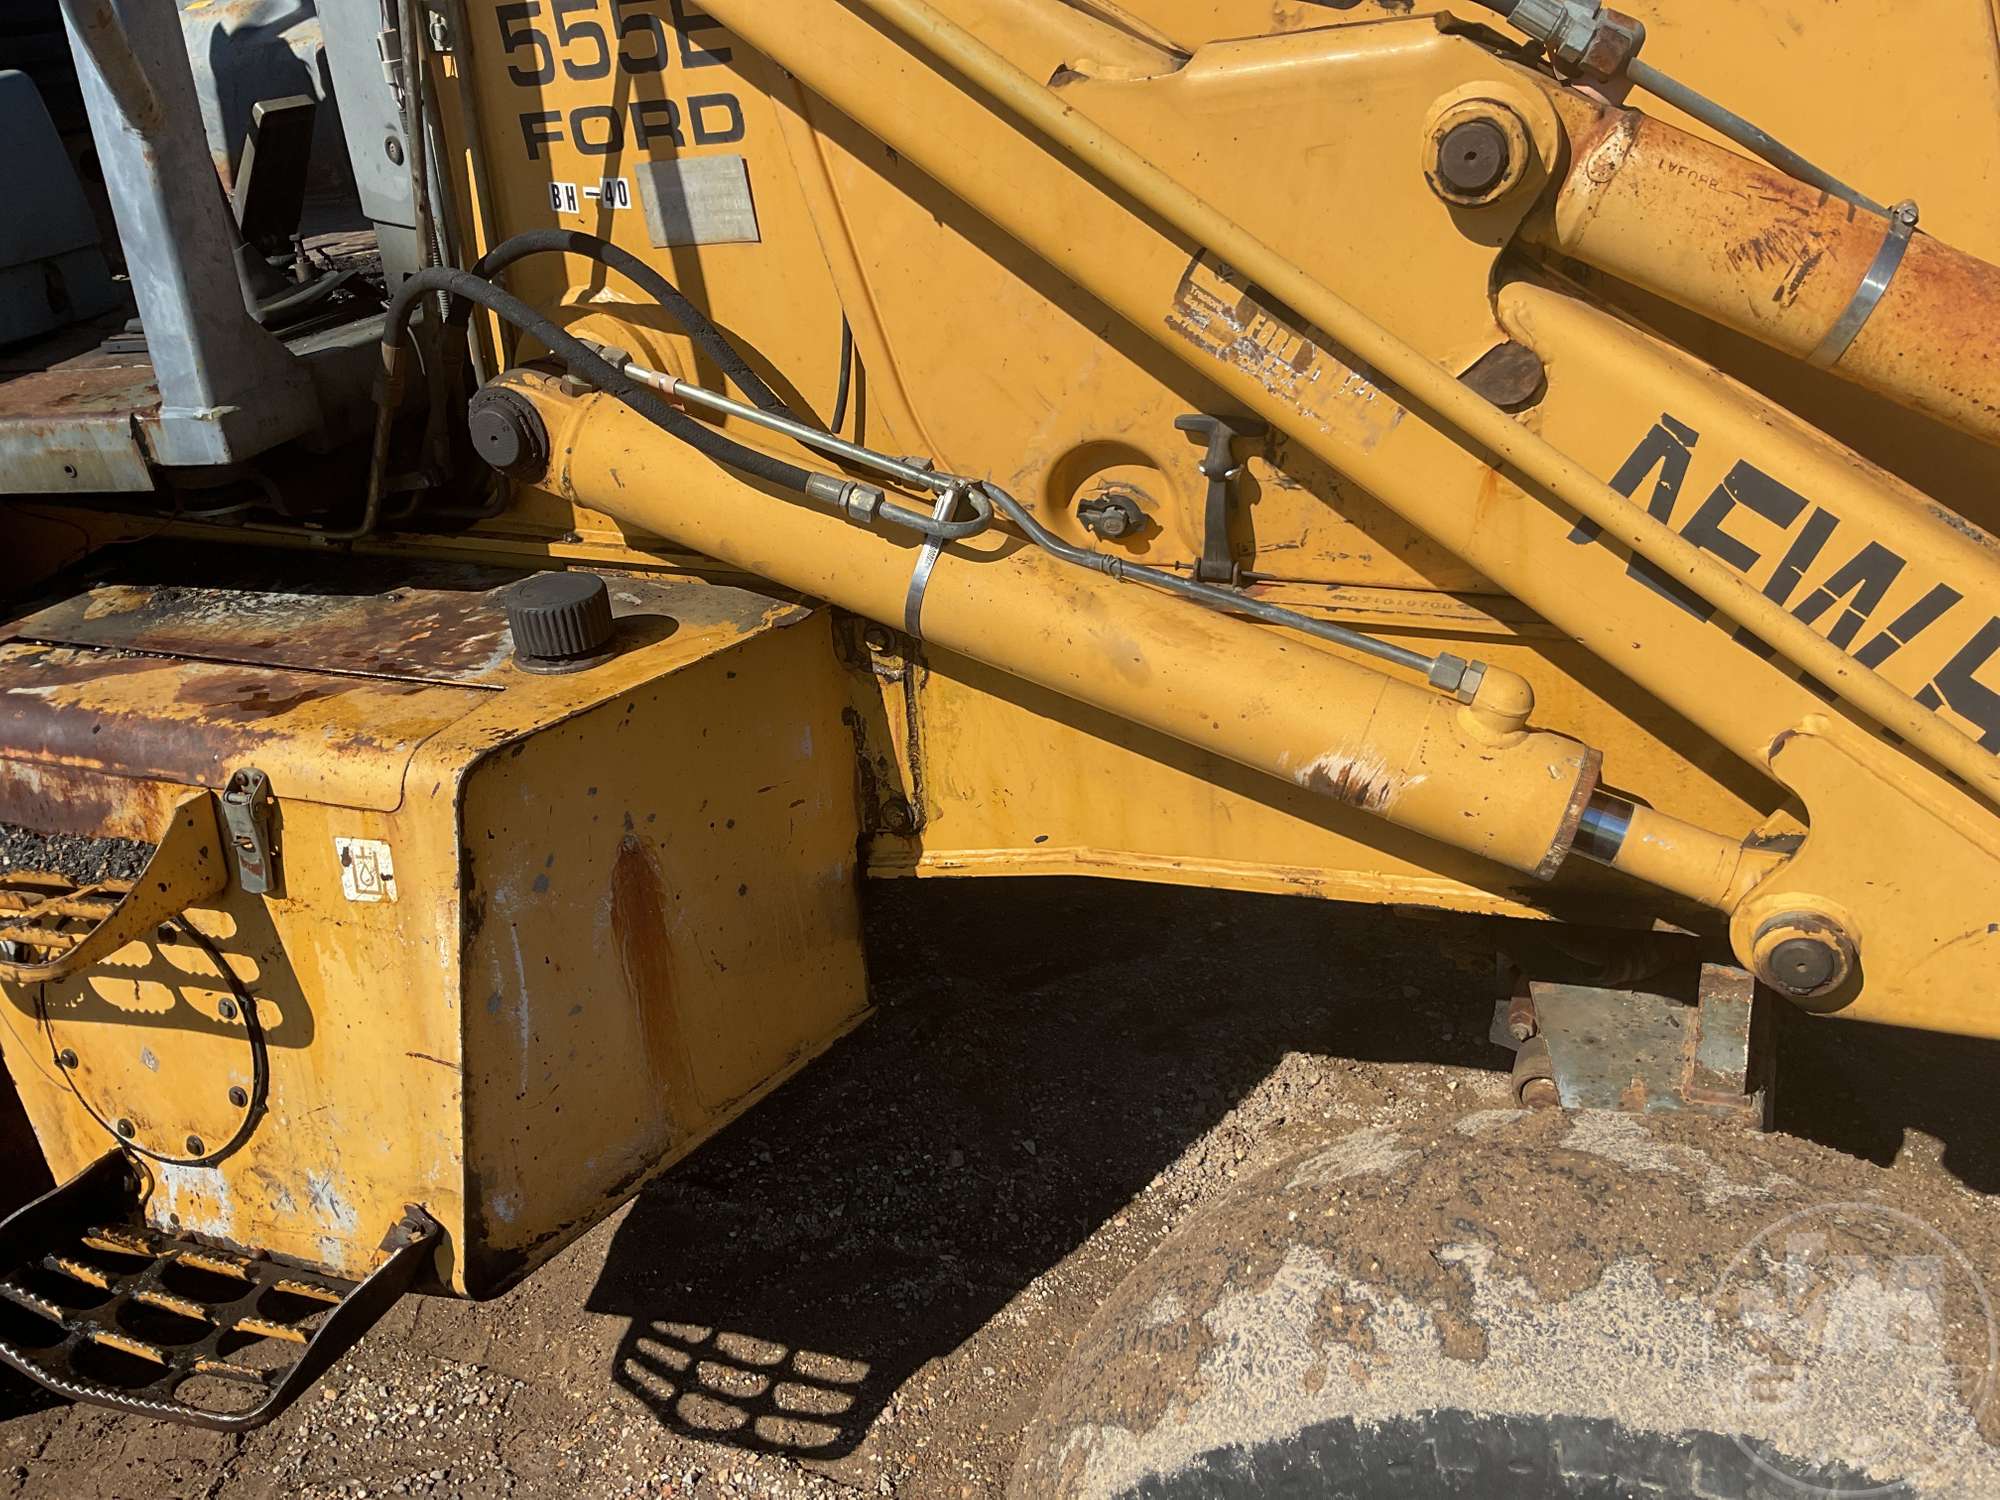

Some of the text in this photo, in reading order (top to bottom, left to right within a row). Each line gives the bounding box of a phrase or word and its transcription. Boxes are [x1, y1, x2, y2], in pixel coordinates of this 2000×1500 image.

[496, 0, 733, 87] 555E
[519, 92, 746, 161] FORD
[1566, 412, 1964, 702] NEW
